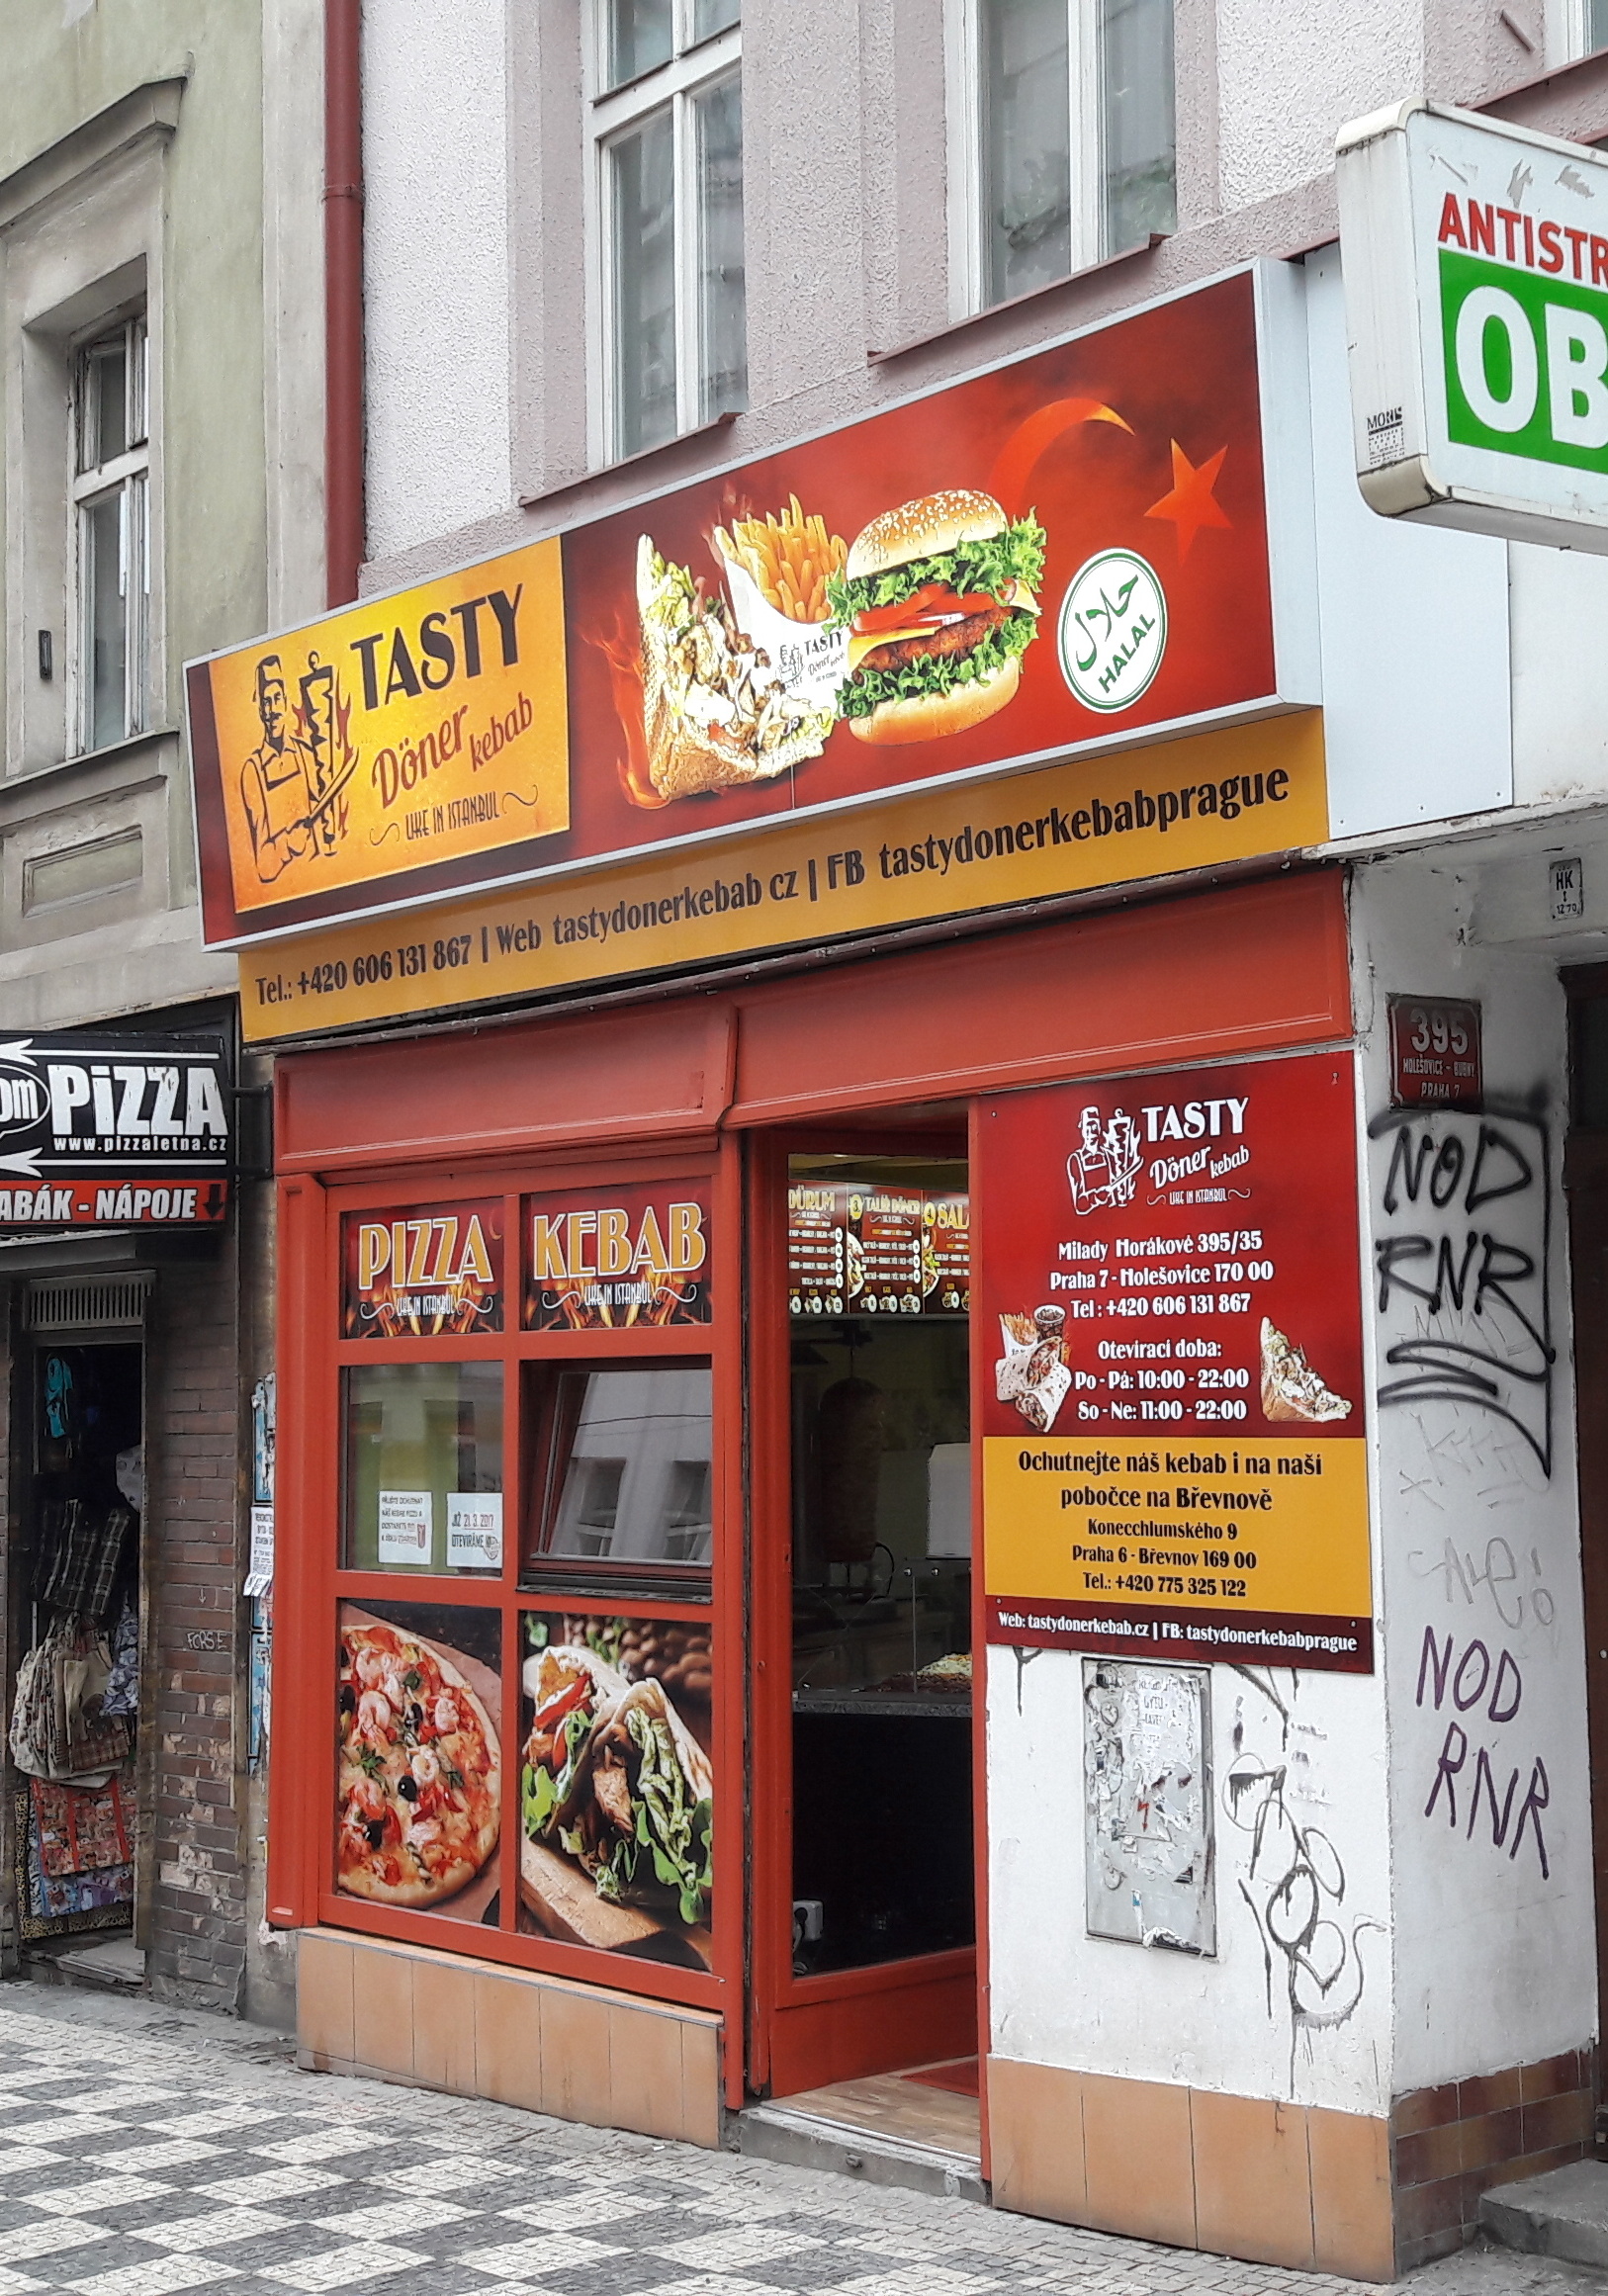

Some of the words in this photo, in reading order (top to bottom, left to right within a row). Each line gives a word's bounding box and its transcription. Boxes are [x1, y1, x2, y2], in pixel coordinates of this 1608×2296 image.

[1438, 192, 1608, 288] ANTISTR
[1456, 285, 1608, 450] OB
[350, 583, 523, 711] TASTY
[1098, 614, 1156, 693] HALAL
[470, 692, 533, 772] kebab
[371, 705, 469, 809] Döner
[405, 809, 429, 840] LIKE
[433, 805, 444, 835] IN
[447, 791, 499, 830] ISTANBUL
[255, 974, 293, 1006] Tel.:
[297, 960, 347, 996] +420
[353, 950, 393, 986] 606
[398, 943, 427, 977] 131
[433, 934, 472, 971] 867
[495, 919, 542, 956] Web
[553, 872, 762, 945] tastydonerkebab
[827, 848, 865, 889] FB
[879, 767, 1290, 879] tastydonerkebabprague
[1556, 870, 1573, 891] HK
[1410, 1008, 1470, 1055] 395
[1421, 1081, 1451, 1099] PRAHA
[1454, 1084, 1461, 1099] 7
[1141, 1097, 1249, 1142] TASTY
[52, 1136, 226, 1152] www.pizzaletna.cz
[1209, 1144, 1250, 1180] kebab
[1149, 1146, 1211, 1190] Döner
[1385, 1123, 1532, 1216] NOD
[0, 1183, 74, 1220] ABÁK
[95, 1183, 198, 1219] NÁPOJE
[1187, 1190, 1194, 1203] IN
[938, 1202, 969, 1229] SAL
[359, 1214, 493, 1290] PIZZA
[533, 1202, 706, 1280] KEBAB
[1058, 1240, 1109, 1263] Milady
[1116, 1234, 1194, 1258] Horákové
[1198, 1230, 1263, 1256] 395/35
[604, 1283, 612, 1304] IN
[615, 1281, 652, 1304] ISTANBUL
[1050, 1271, 1096, 1290] Praha
[1099, 1269, 1109, 1288] 7
[1119, 1264, 1211, 1286] Holešovice
[1213, 1262, 1244, 1282] 170
[1247, 1260, 1274, 1281] 00
[1106, 1296, 1148, 1317] +420
[1152, 1295, 1187, 1315] 606
[1190, 1294, 1214, 1314] 131
[1218, 1292, 1251, 1313] 867
[1175, 1338, 1222, 1358] doba:
[1075, 1370, 1097, 1390] Po
[1109, 1369, 1134, 1389] Pá:
[1137, 1369, 1186, 1389] 10:00
[1198, 1368, 1249, 1388] 22:00
[1078, 1400, 1100, 1420] So
[1111, 1400, 1137, 1420] Ne:
[1140, 1400, 1183, 1420] 11:00
[1196, 1399, 1247, 1420] 22:00
[1019, 1451, 1120, 1475] Ochutnejte
[1126, 1452, 1160, 1472] náš
[1166, 1452, 1227, 1473] kebab
[1232, 1451, 1239, 1473] i
[1245, 1457, 1271, 1474] na
[1061, 1485, 1141, 1509] pobočce
[1146, 1490, 1170, 1507] na
[1176, 1486, 1273, 1511] Břevnově
[1088, 1518, 1223, 1540] Konecchlumského
[1227, 1523, 1238, 1541] 9
[1072, 1545, 1115, 1562] Praha
[1117, 1546, 1127, 1563] 6
[1138, 1547, 1200, 1567] Břevnov
[1203, 1549, 1229, 1568] 169
[1233, 1551, 1257, 1569] 00
[1083, 1571, 1112, 1590] Tel.:
[1115, 1574, 1154, 1592] +420
[1157, 1575, 1184, 1594] 775
[1188, 1577, 1217, 1596] 325
[1220, 1579, 1246, 1597] 122
[998, 1611, 1026, 1629] Web:
[1027, 1614, 1150, 1637] tastydonerkebab.cz
[1161, 1623, 1184, 1639] FB:
[1187, 1624, 1358, 1653] tastydonerkebabprague
[1417, 1625, 1521, 1722] NOD
[1425, 1721, 1550, 1880] RNR
